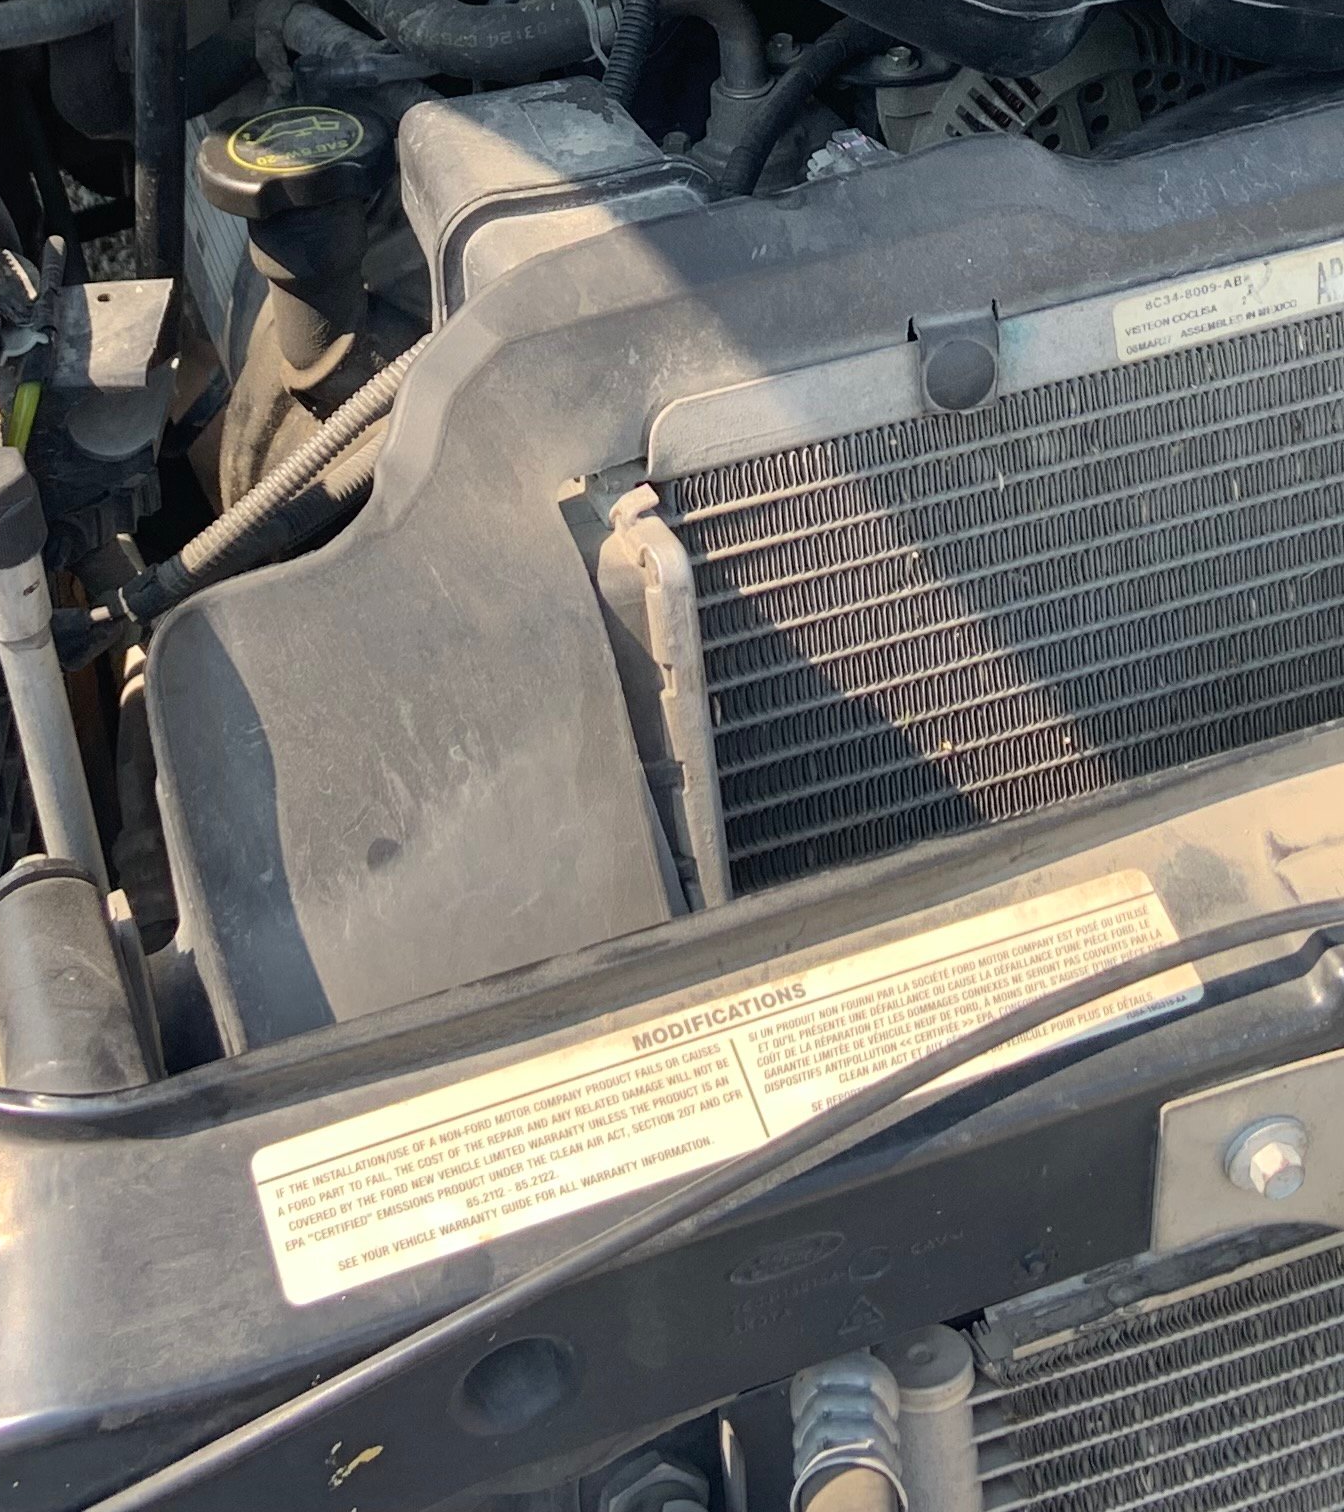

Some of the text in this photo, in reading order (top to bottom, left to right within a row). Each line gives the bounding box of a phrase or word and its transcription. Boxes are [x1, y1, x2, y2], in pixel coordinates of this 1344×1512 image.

[1180, 314, 1244, 338] ASSEMBLED
[630, 982, 807, 1051] MODIFICATIONS
[747, 1030, 758, 1042] SI
[759, 1025, 774, 1038] UN
[775, 1012, 815, 1033] PRODUIT
[817, 1004, 839, 1019] NON
[840, 993, 875, 1012] FOURNI
[875, 986, 895, 1001] PAR
[896, 981, 910, 994] LA
[950, 960, 976, 976] FORD
[977, 949, 1010, 968] MOTOR
[1010, 935, 1054, 957] COMPANY
[1055, 929, 1073, 942] EST
[1099, 916, 1114, 928] OU
[757, 1041, 769, 1053] ET
[771, 1033, 795, 1048] QU'IL
[847, 1009, 868, 1024] UNE
[931, 984, 946, 996] OU
[946, 974, 977, 992] CAUSE
[978, 969, 992, 981] LA
[1054, 940, 1081, 957] D'UNE
[1109, 923, 1136, 940] FORD,
[1137, 918, 1150, 929] LE
[763, 1056, 811, 1080] GARANTIE
[851, 1038, 865, 1050] DE
[913, 1014, 937, 1030] NEUF
[938, 1009, 952, 1022] DE
[953, 1000, 980, 1018] FORD,
[991, 986, 1023, 1004] MOINS
[1023, 978, 1046, 994] QU'IL
[783, 1046, 797, 1059] DE
[798, 1041, 812, 1054] LA
[872, 1018, 885, 1030] ET
[886, 1011, 905, 1025] LES
[907, 993, 959, 1019] DOMMAGES
[961, 977, 1008, 1001] CONNEXES
[1010, 972, 1023, 984] NE
[1024, 960, 1061, 980] SERONT
[1062, 954, 1081, 967] PAS
[1081, 938, 1129, 961] COUVERTS
[1129, 932, 1148, 946] PAR
[1148, 927, 1162, 939] LA
[1050, 1016, 1075, 1033] POUR
[1077, 1008, 1100, 1024] PLUS
[1102, 1003, 1115, 1016] DE
[763, 1066, 822, 1094] DISPOSITIFS
[823, 1041, 898, 1074] ANTIPOLLUTION
[811, 1099, 823, 1112] SE
[837, 1065, 870, 1084] CLEAN
[871, 1059, 888, 1073] AIR
[889, 1052, 908, 1066] ACT
[910, 1047, 922, 1060] ET
[274, 1042, 722, 1199] IF THE INSTALLATION/USE OF A NON-FORD MOTOR COMPANY PRODUCT FAILS OR CAUSES
[276, 1057, 730, 1216] A FORD PART TO FAIL, THE COST OF THE REPAIR AND ANY RELATED DAMAGE WILL NOT BE
[283, 1236, 306, 1252] EPA
[375, 1192, 436, 1221] EMISSIONS
[435, 1175, 486, 1200] PRODUCT
[487, 1162, 525, 1183] UNDER
[526, 1154, 548, 1169] THE
[548, 1142, 585, 1162] CLEAN
[584, 1135, 605, 1150] AIR
[605, 1126, 631, 1144] ACT,
[630, 1111, 676, 1134] SECTION
[676, 1104, 697, 1119] 207
[697, 1096, 722, 1111] AND
[721, 1088, 744, 1103] CFR
[287, 1074, 730, 1231] COVERED BY THE FORD NEW VEHICLE LIMITED WARRANTY UNLESS THE PRODUCT IS AN
[336, 1255, 359, 1271] SEE
[360, 1244, 391, 1263] YOUR
[391, 1228, 437, 1252] VEHICLE
[438, 1207, 499, 1236] WARRANTY
[499, 1196, 533, 1215] GUIDE
[533, 1187, 557, 1203] FOR
[557, 1181, 577, 1195] ALL
[579, 1160, 639, 1188] WARRANTY
[464, 1186, 506, 1208] 85.2112
